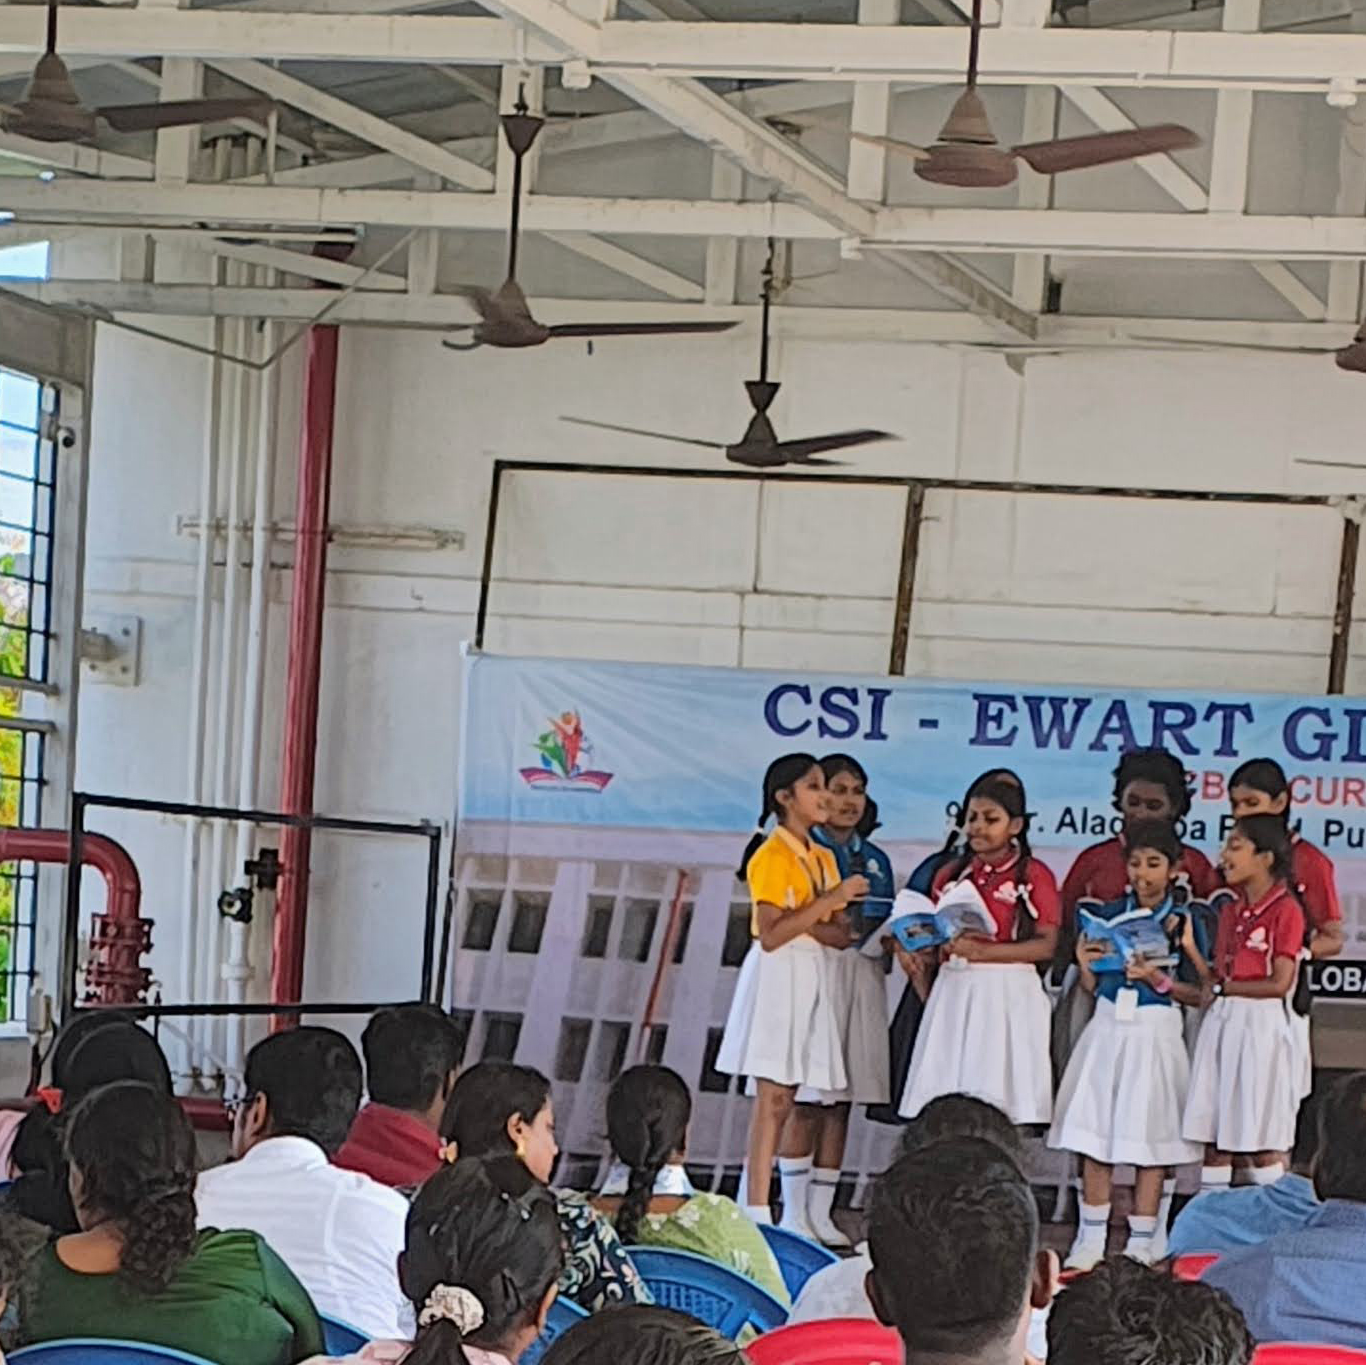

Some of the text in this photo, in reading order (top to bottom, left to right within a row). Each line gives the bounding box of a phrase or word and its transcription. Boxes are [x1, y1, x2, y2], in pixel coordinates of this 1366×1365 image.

[764, 684, 892, 741] CSI
[919, 718, 939, 729] -
[969, 693, 1255, 757] EWART
